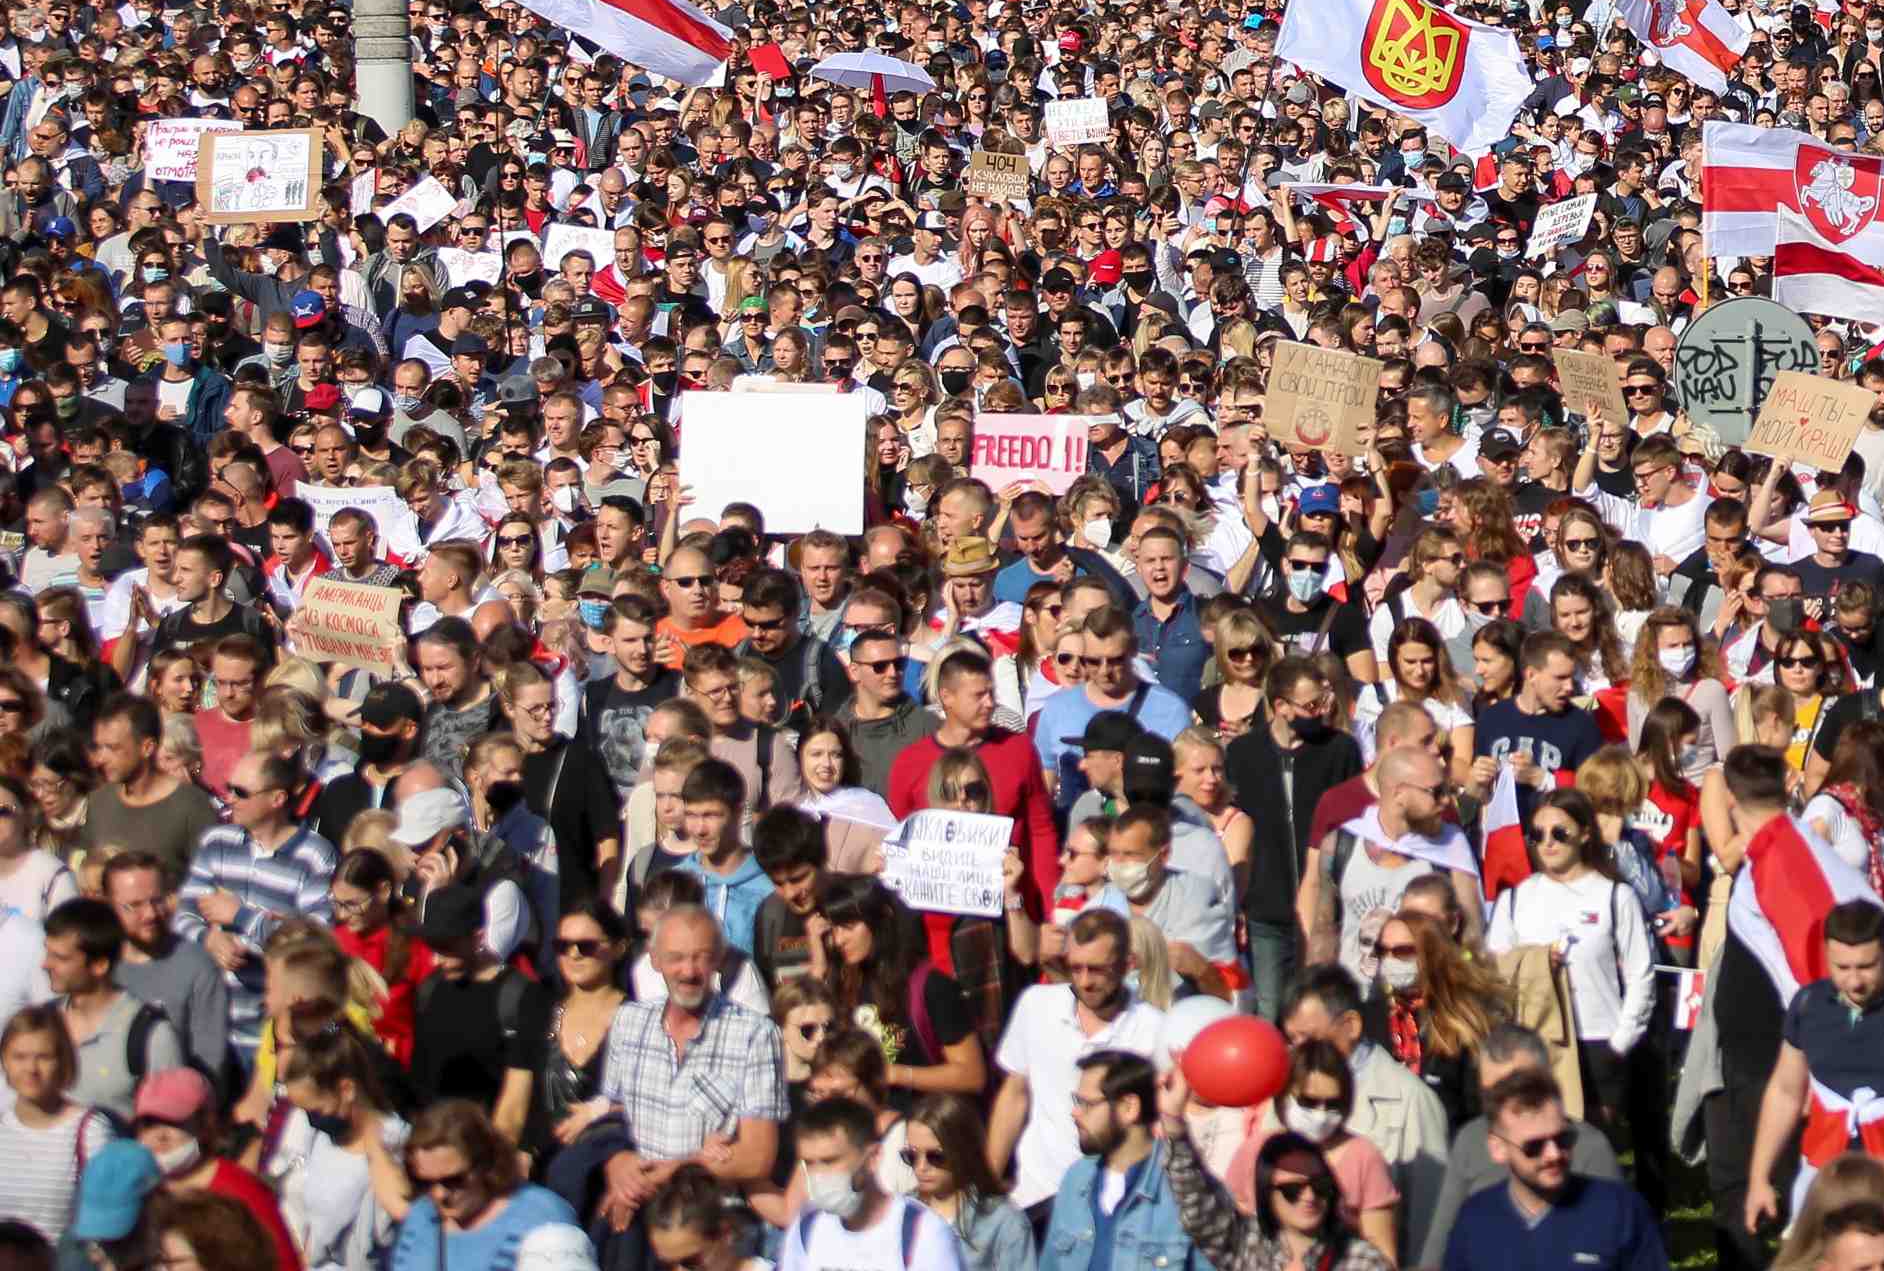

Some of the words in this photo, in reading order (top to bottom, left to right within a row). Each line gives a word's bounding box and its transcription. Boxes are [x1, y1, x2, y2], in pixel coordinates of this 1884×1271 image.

[986, 154, 1017, 172] 404
[971, 182, 986, 193] НЕ
[974, 169, 1027, 185] КУКЛОВОД
[1753, 418, 1796, 448] МОЙ
[313, 585, 388, 613] АМЕРИКАНЦЫ
[326, 612, 383, 639] КОСМОСА
